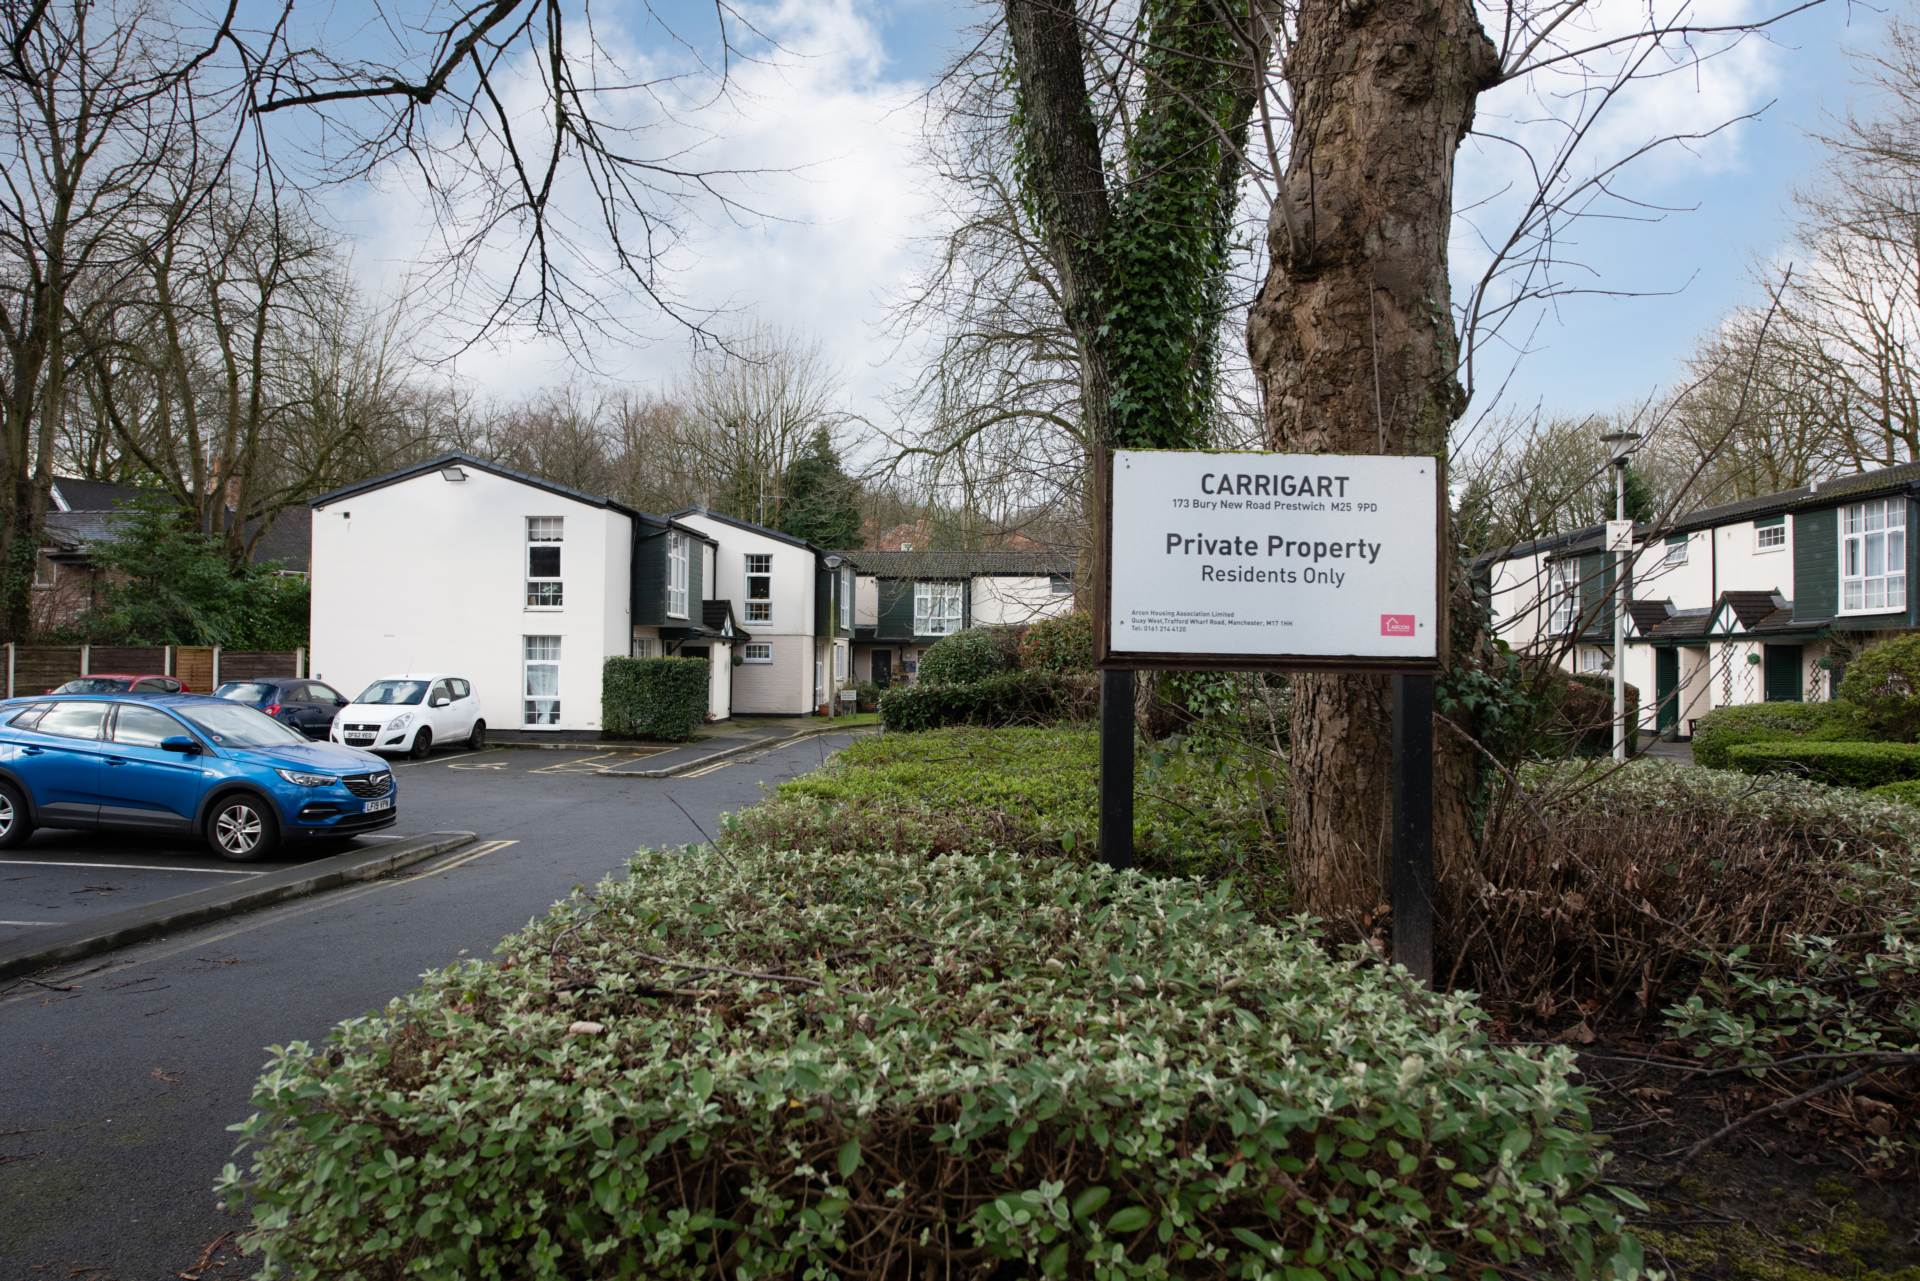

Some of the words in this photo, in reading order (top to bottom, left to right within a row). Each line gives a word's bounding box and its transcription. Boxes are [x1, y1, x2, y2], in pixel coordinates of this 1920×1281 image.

[1201, 473, 1350, 498] CARRIGART
[1172, 499, 1190, 509] 173
[1193, 499, 1218, 511] Bury
[1220, 500, 1243, 510] New
[1246, 500, 1271, 511] Road
[1274, 500, 1326, 512] Prestwich
[1331, 502, 1352, 512] M25
[1358, 503, 1378, 513] 9PD
[1166, 533, 1258, 557] Private
[1267, 535, 1382, 564] Property
[1201, 565, 1297, 584] Residents
[1303, 567, 1346, 588] Only
